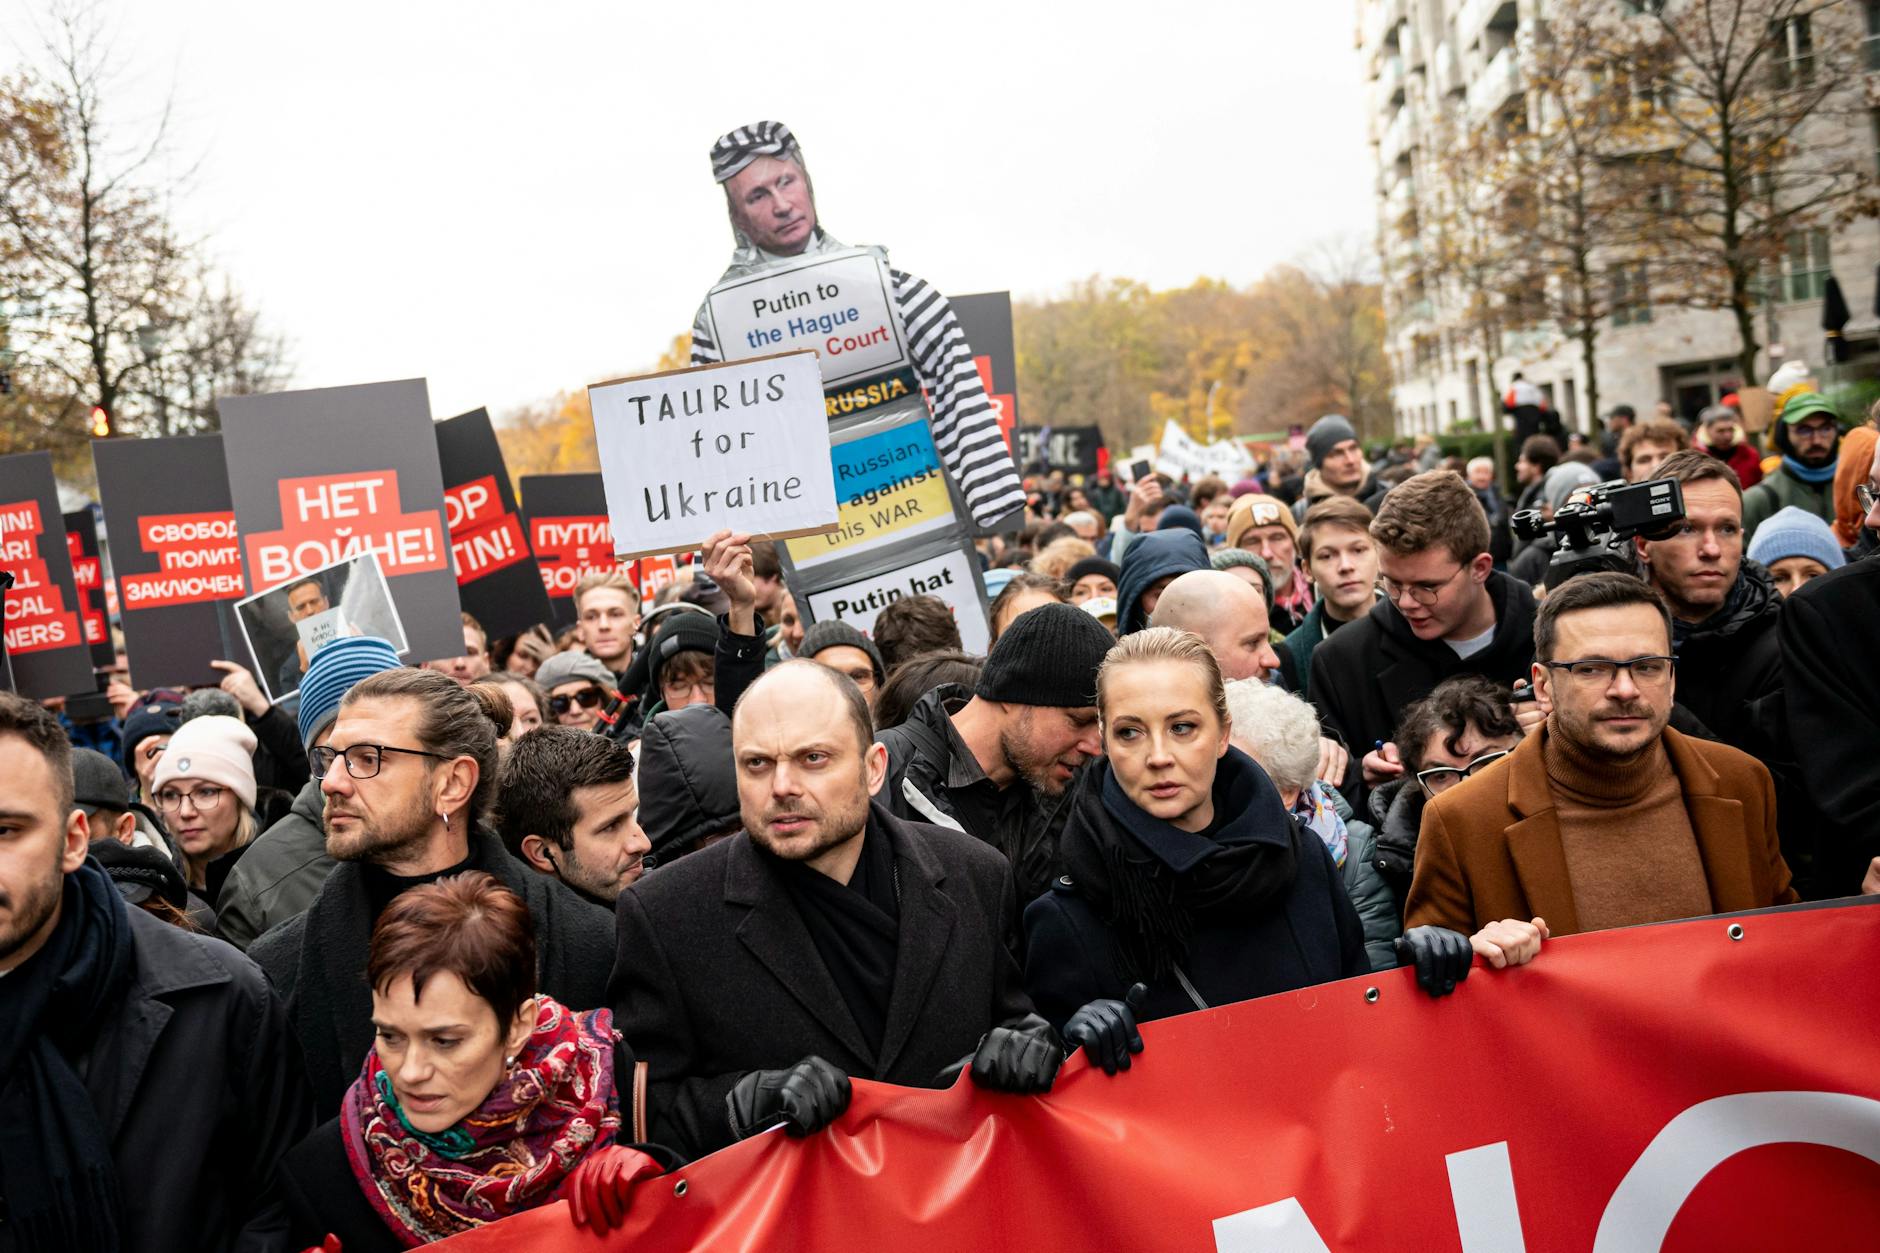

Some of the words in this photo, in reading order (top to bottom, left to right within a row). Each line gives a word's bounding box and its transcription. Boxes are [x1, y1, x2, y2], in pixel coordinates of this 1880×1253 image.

[753, 290, 811, 318] Putin
[816, 284, 839, 301] to
[747, 327, 783, 349] the
[787, 307, 860, 338] Hague
[826, 325, 889, 356] Court
[628, 373, 786, 425] TAURUS
[826, 378, 908, 416] RUSSIA
[690, 429, 755, 458] for
[296, 478, 384, 522] НЕТ
[644, 476, 802, 523] Ukraine
[850, 463, 938, 507] against
[1649, 496, 1671, 505] SONY
[870, 497, 923, 529] WAR
[259, 526, 436, 582] ВОЙНЕ!
[126, 574, 243, 601] ЗАКЛЮЧЕН
[832, 587, 900, 619] Putin
[909, 567, 953, 596] hat
